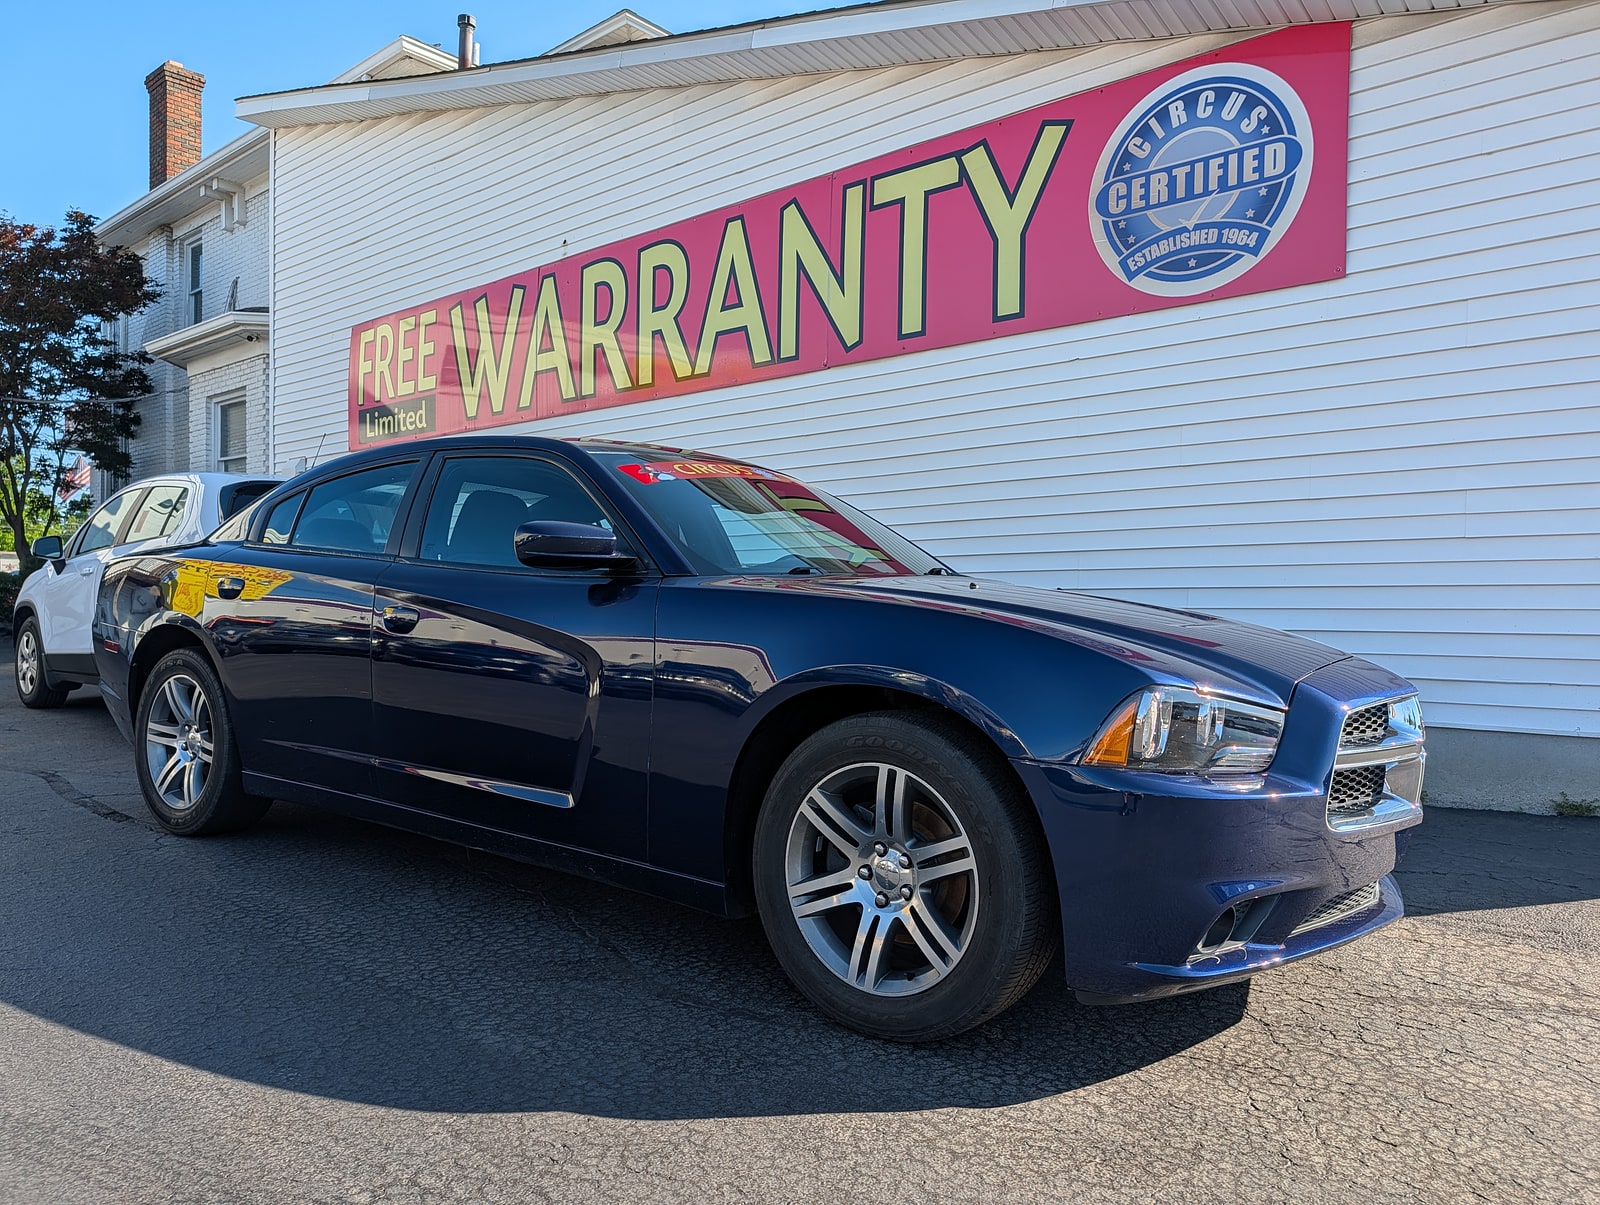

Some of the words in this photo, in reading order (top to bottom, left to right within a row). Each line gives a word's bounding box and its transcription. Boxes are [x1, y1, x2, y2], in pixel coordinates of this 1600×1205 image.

[1127, 89, 1268, 159] CIRCUS
[1107, 142, 1287, 215] CERTIFIED
[357, 308, 438, 407] FREE
[449, 119, 1075, 422] WARRANTY
[1126, 227, 1219, 272] ESTABLISHED
[1221, 227, 1259, 248] 1964
[365, 399, 428, 438] Limited
[673, 462, 752, 476] CIRCUS
